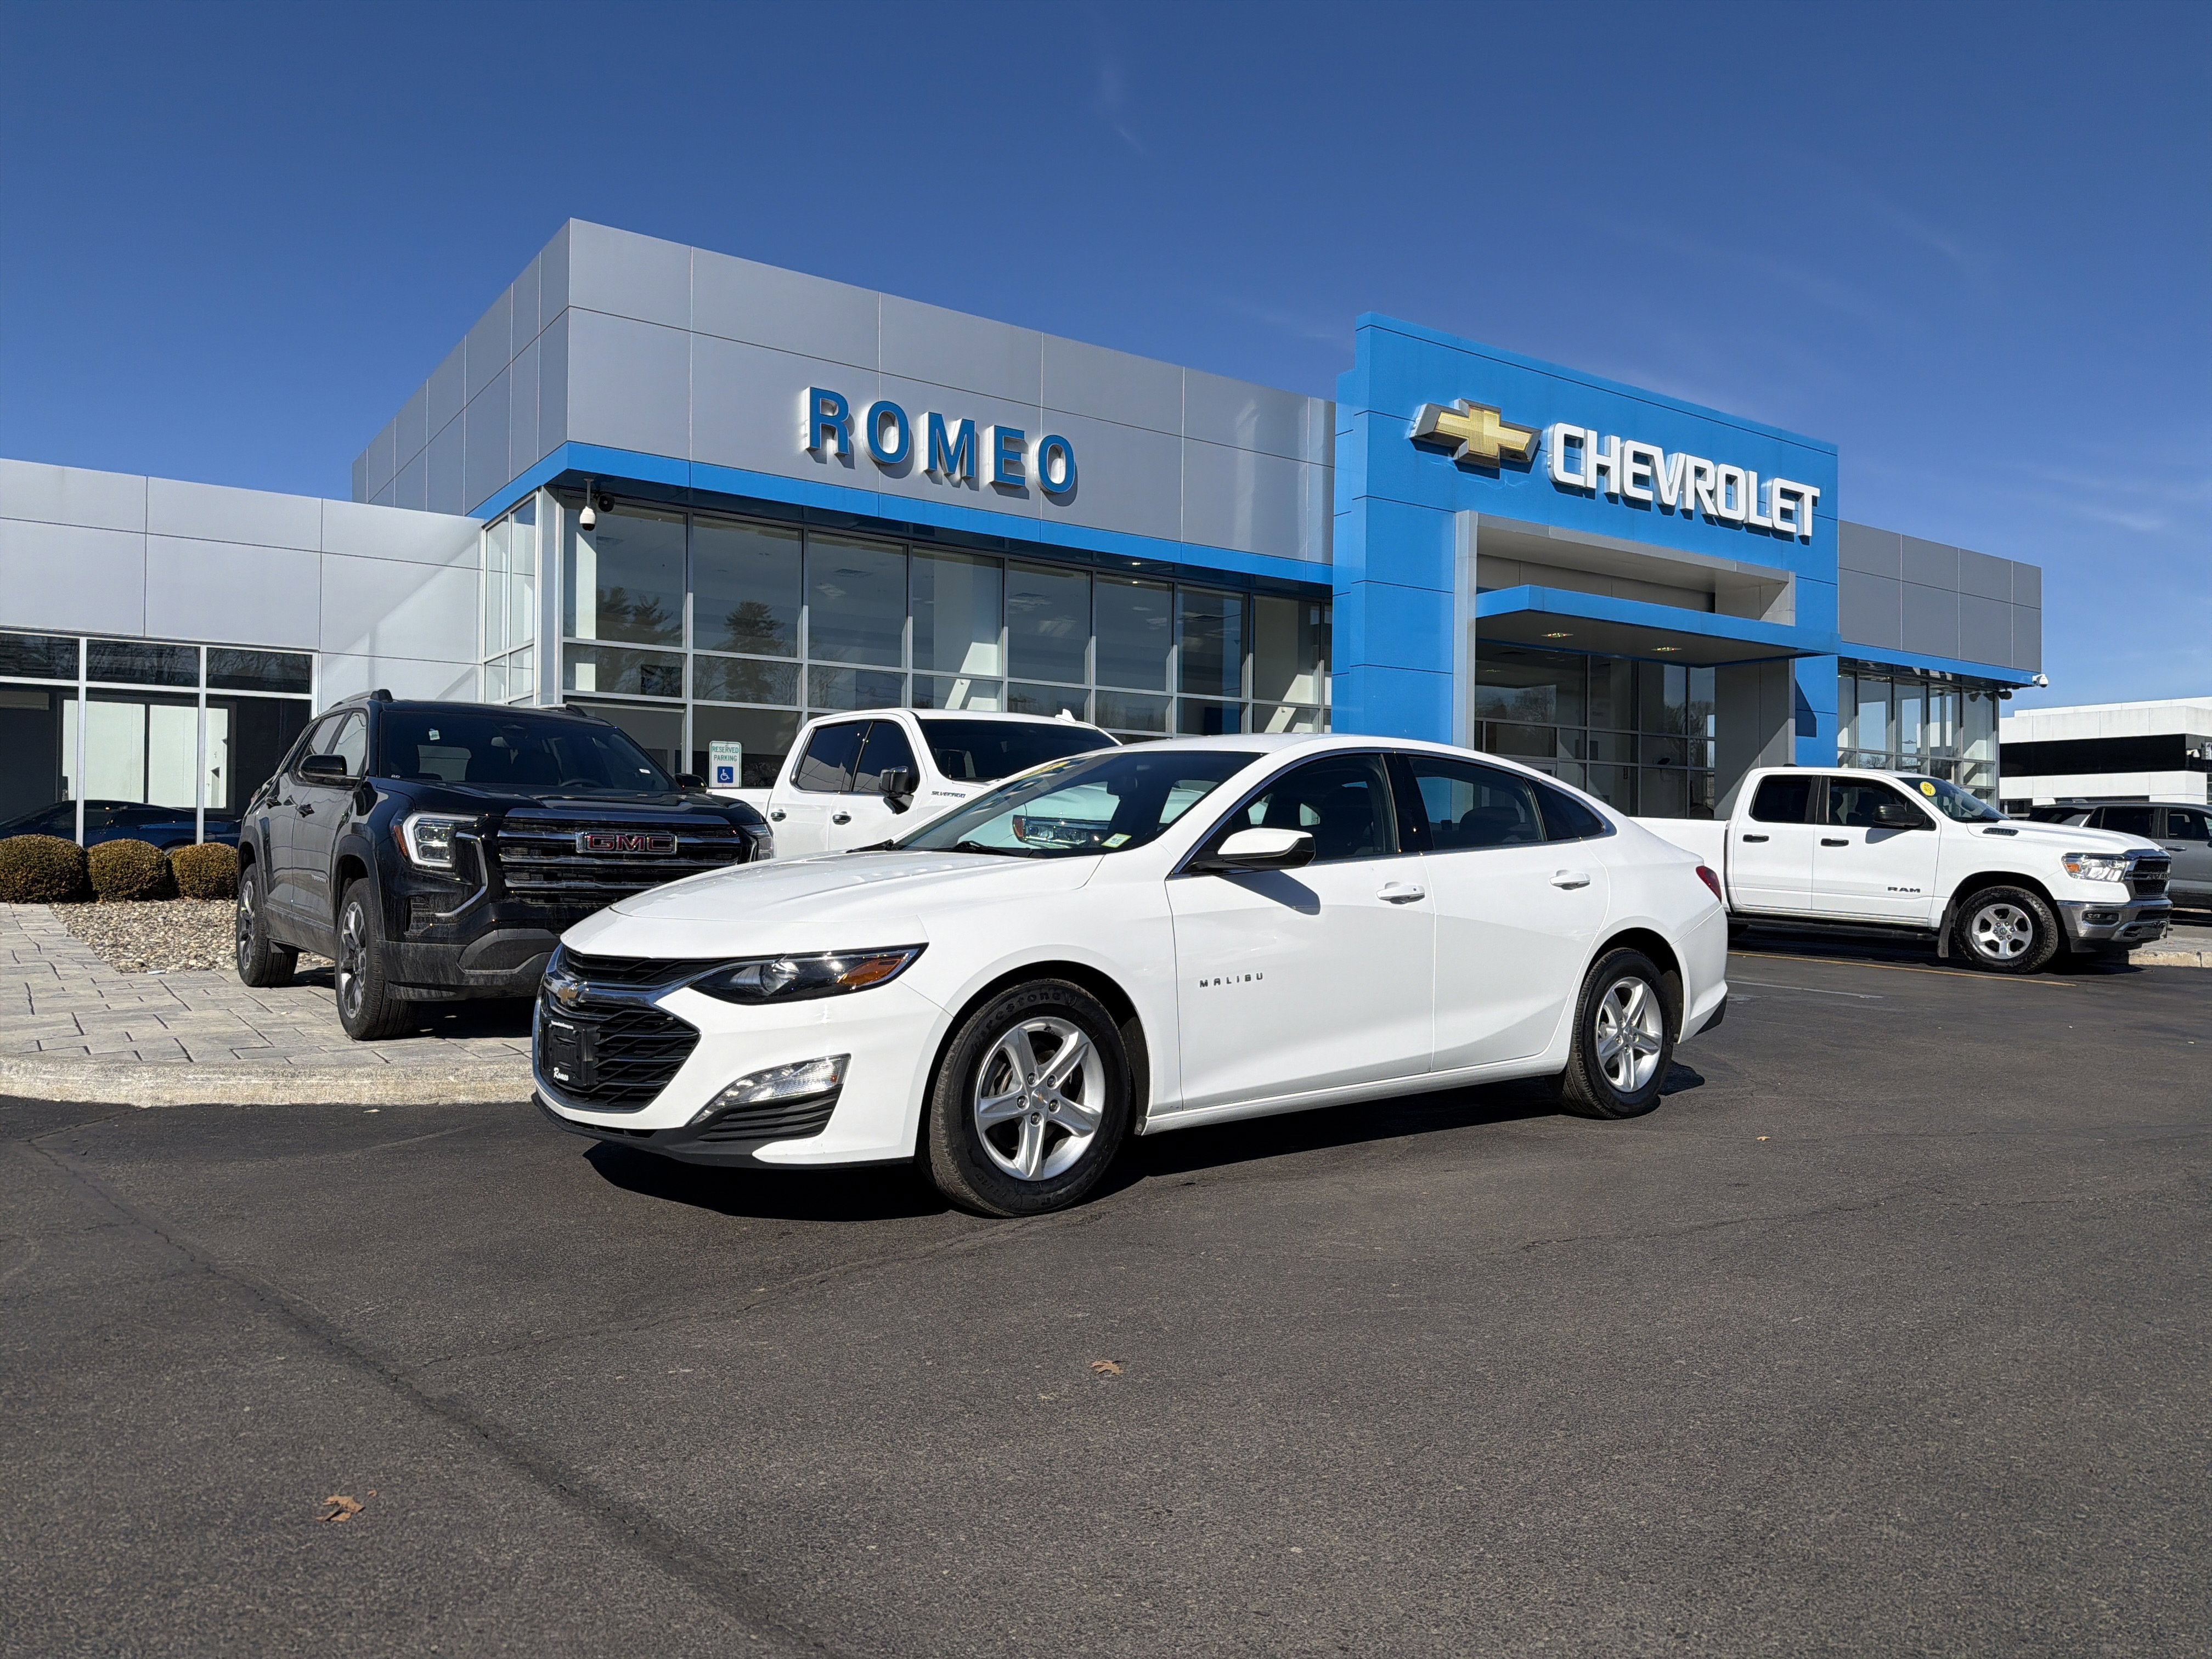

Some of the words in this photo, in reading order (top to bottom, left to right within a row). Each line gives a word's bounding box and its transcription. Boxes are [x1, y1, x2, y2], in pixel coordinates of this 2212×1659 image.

[805, 387, 1076, 493] ROMEO
[1548, 422, 1820, 537] CHEVROLET
[587, 834, 672, 851] GMC
[1200, 972, 1263, 988] MALIBU
